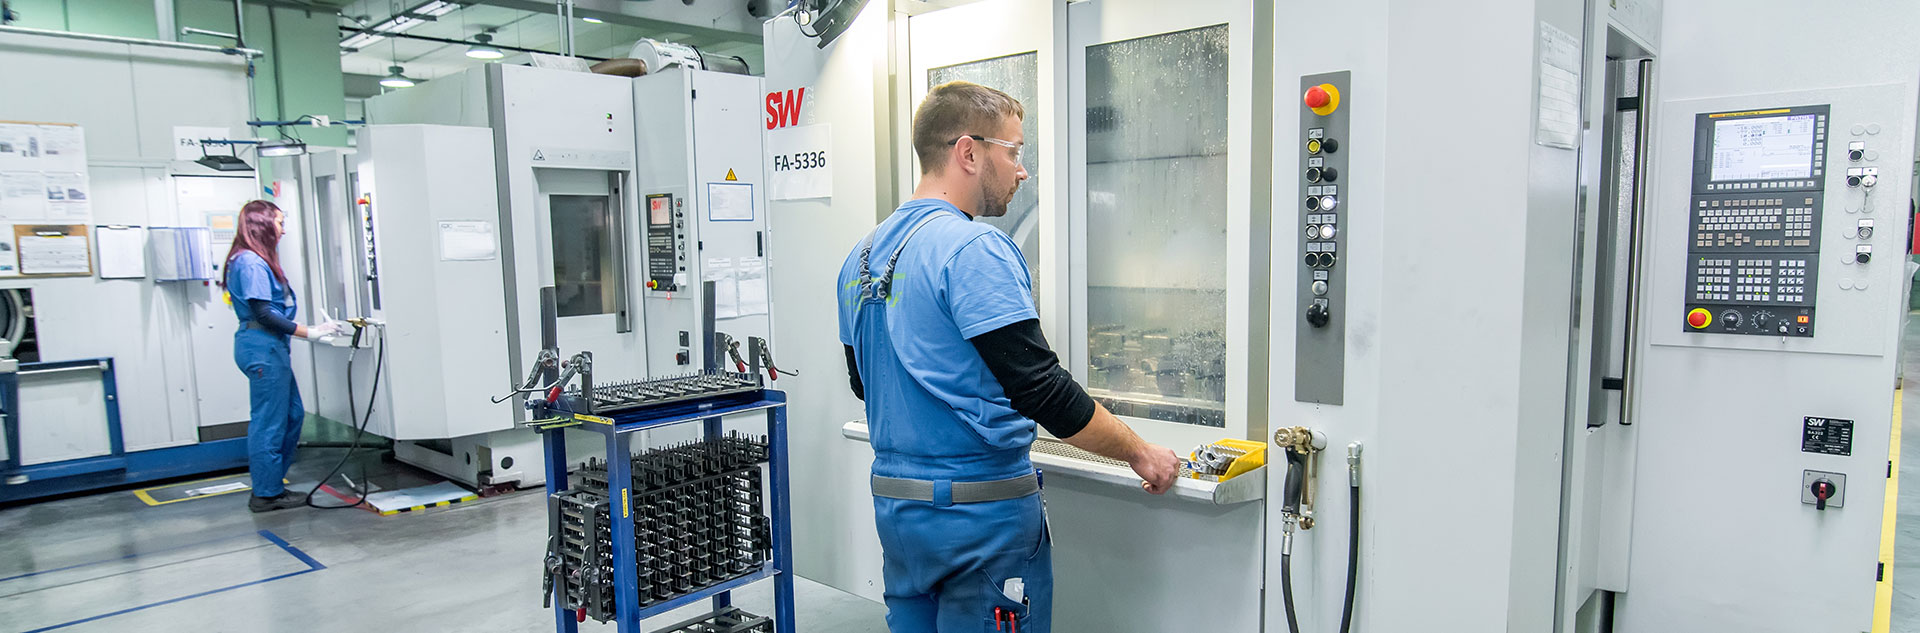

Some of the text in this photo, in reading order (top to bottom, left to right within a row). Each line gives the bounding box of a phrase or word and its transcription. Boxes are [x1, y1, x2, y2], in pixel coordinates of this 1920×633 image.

[807, 85, 815, 107] 322
[766, 87, 805, 130] SW
[774, 151, 826, 171] FA-5336
[1808, 418, 1825, 426] SW
